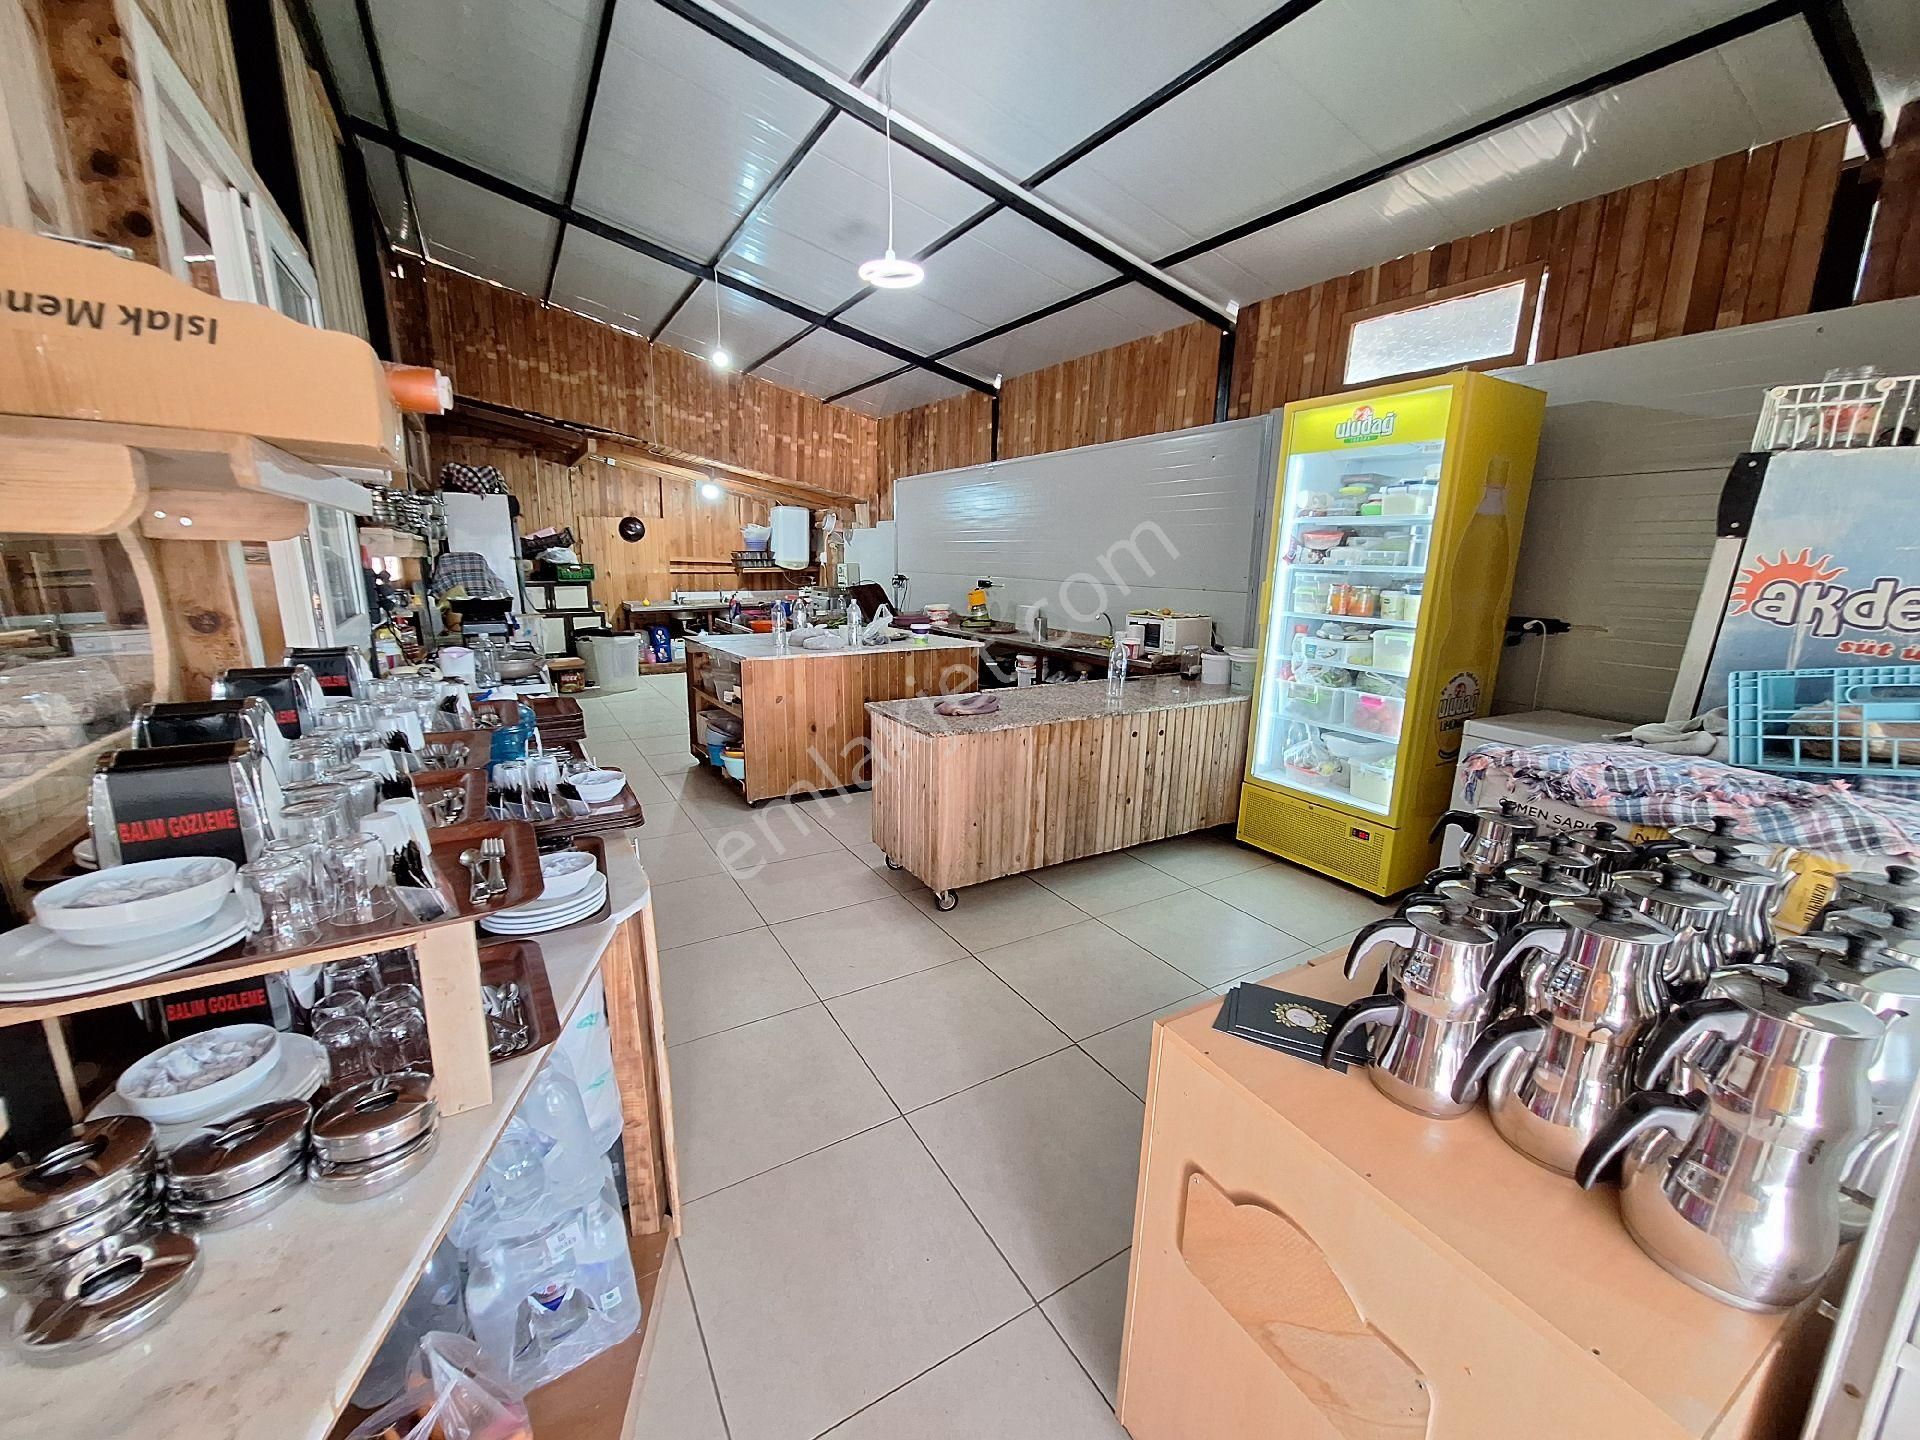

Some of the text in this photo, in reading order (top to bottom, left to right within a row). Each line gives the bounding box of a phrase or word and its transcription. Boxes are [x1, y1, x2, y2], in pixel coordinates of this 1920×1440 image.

[0, 289, 218, 345] Islak Men
[1836, 638, 1896, 659] süt
